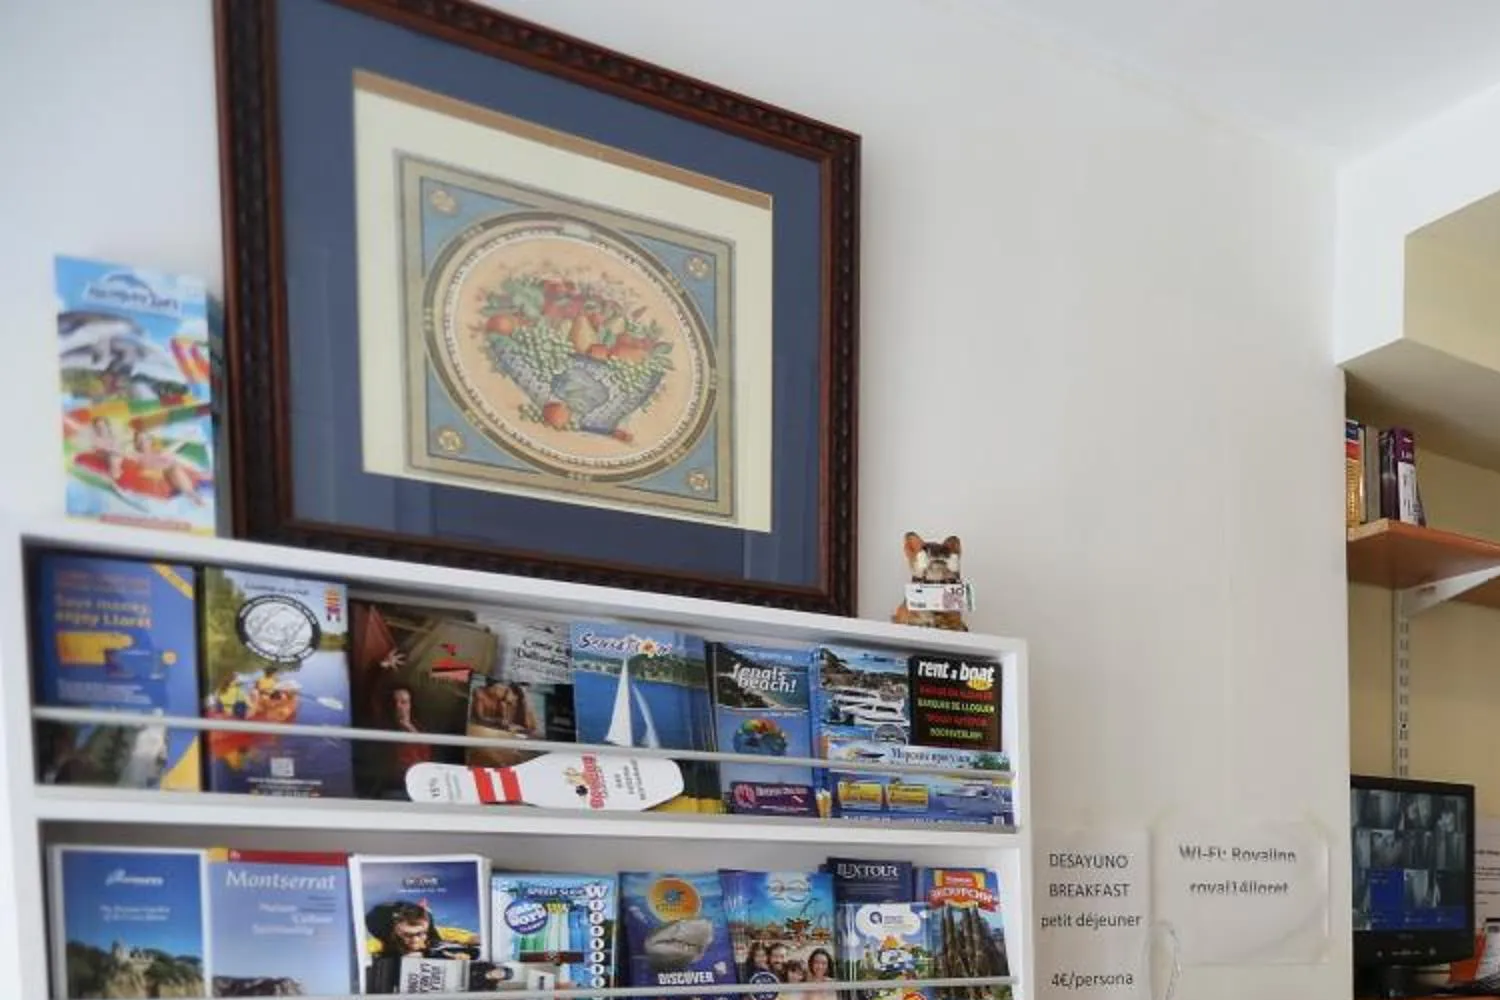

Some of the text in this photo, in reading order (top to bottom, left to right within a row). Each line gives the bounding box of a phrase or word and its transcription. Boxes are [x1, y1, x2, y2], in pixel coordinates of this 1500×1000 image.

[917, 660, 949, 679] rent
[959, 662, 995, 683] boat
[1049, 854, 1129, 869] DESAYUNO
[226, 869, 336, 890] Montserrat
[1049, 883, 1130, 897] BREAKFAST
[1041, 912, 1142, 930] petit déjeuner
[1051, 972, 1134, 990] 4€/persona
